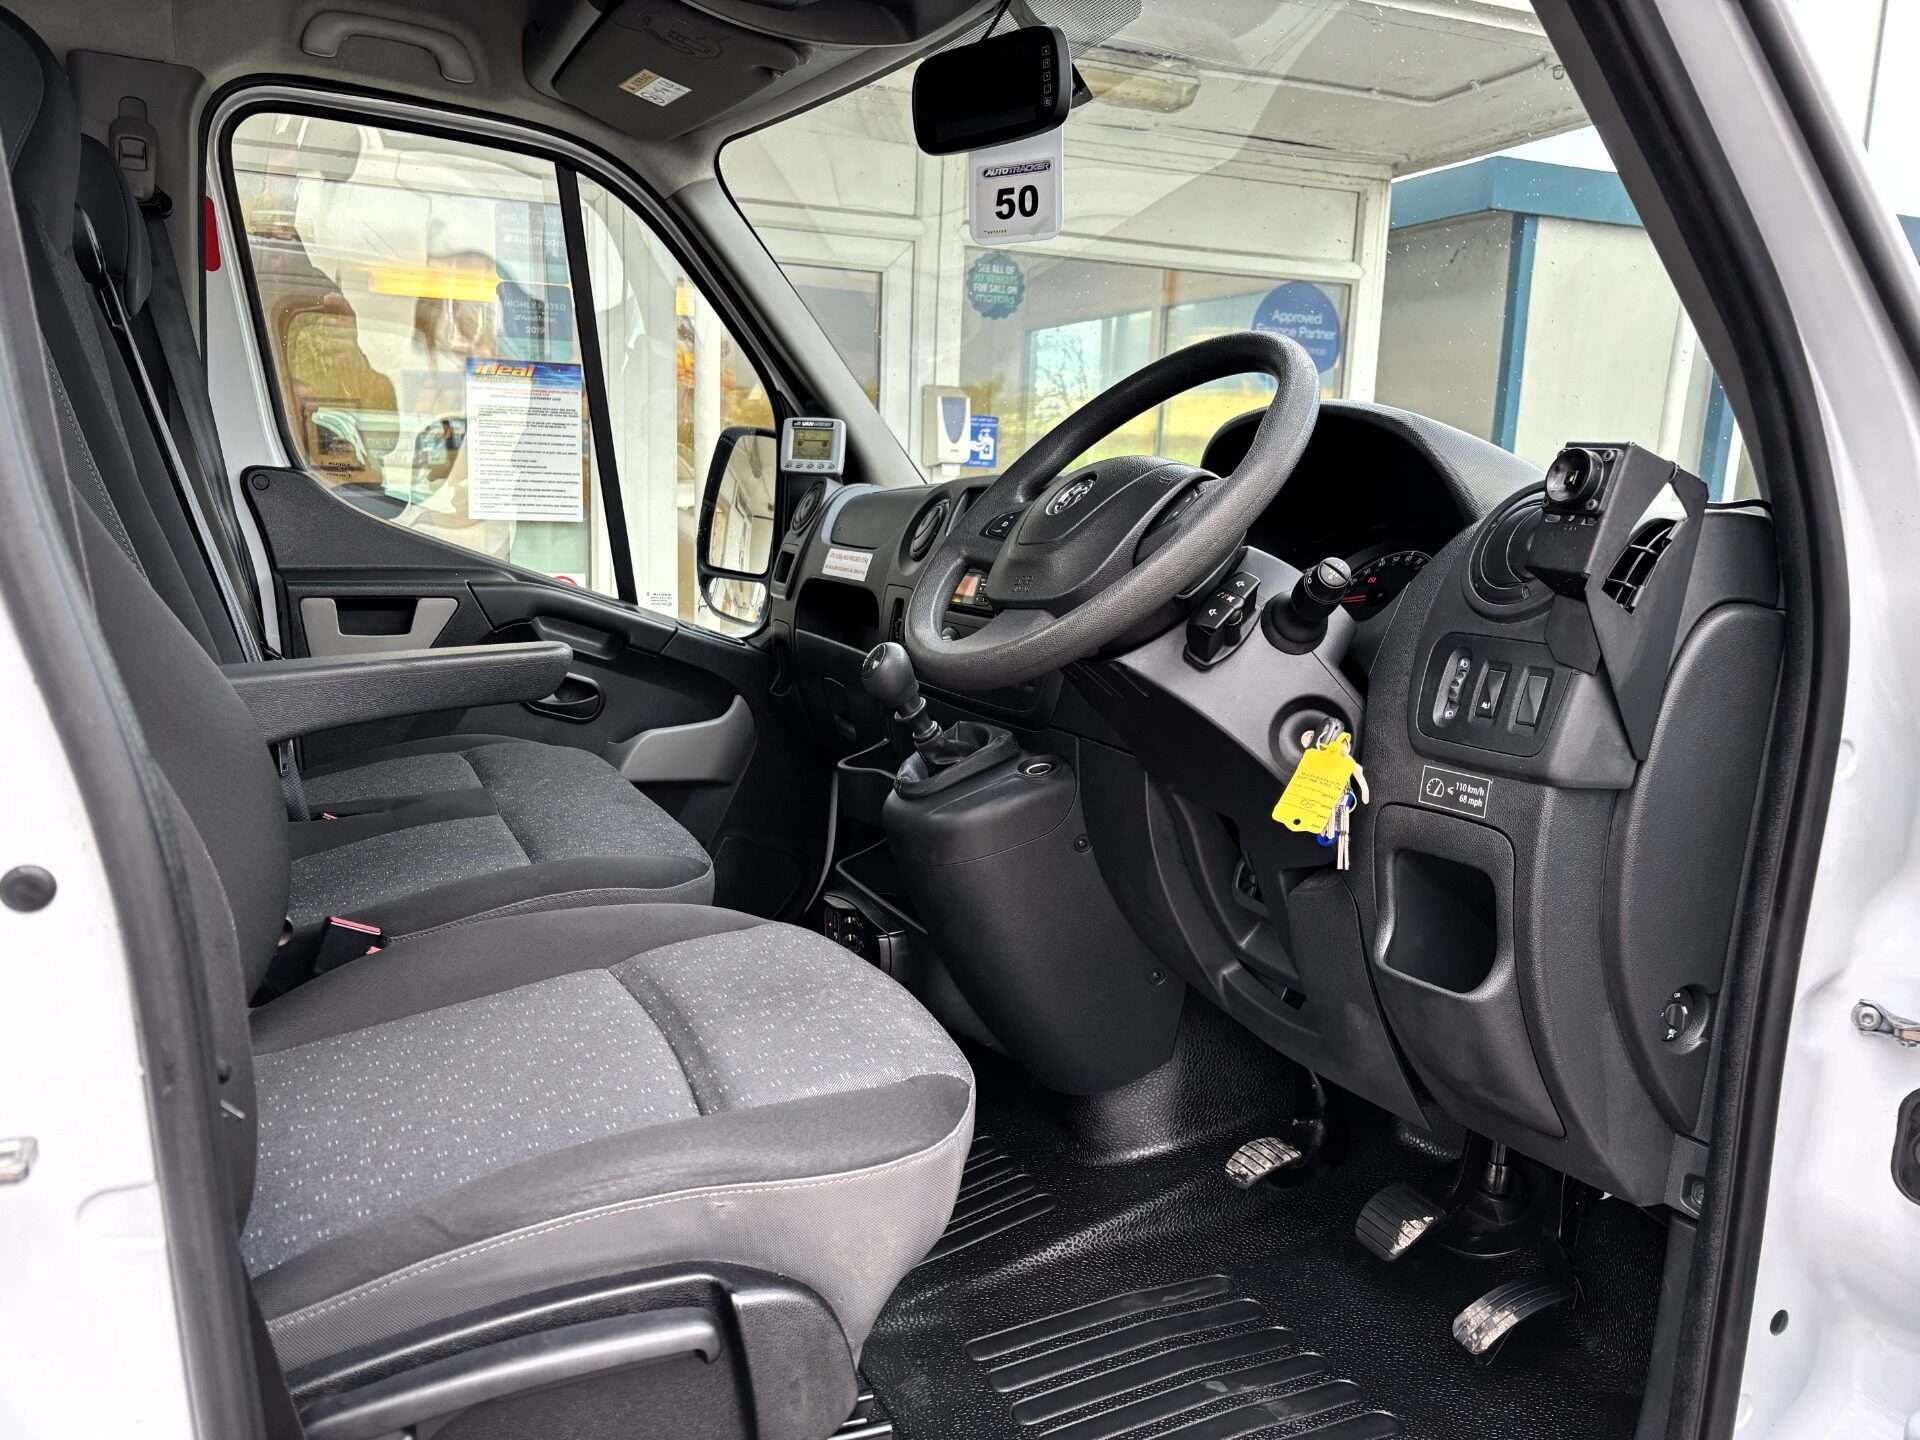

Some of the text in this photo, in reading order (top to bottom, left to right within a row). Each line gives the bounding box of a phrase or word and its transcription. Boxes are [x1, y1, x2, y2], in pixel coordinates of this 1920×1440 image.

[995, 185, 1039, 219] 50
[1271, 309, 1323, 325] Approved
[1298, 326, 1336, 340] Partner
[1456, 782, 1484, 796] 110 km/h
[1459, 794, 1482, 807] 68 mph
